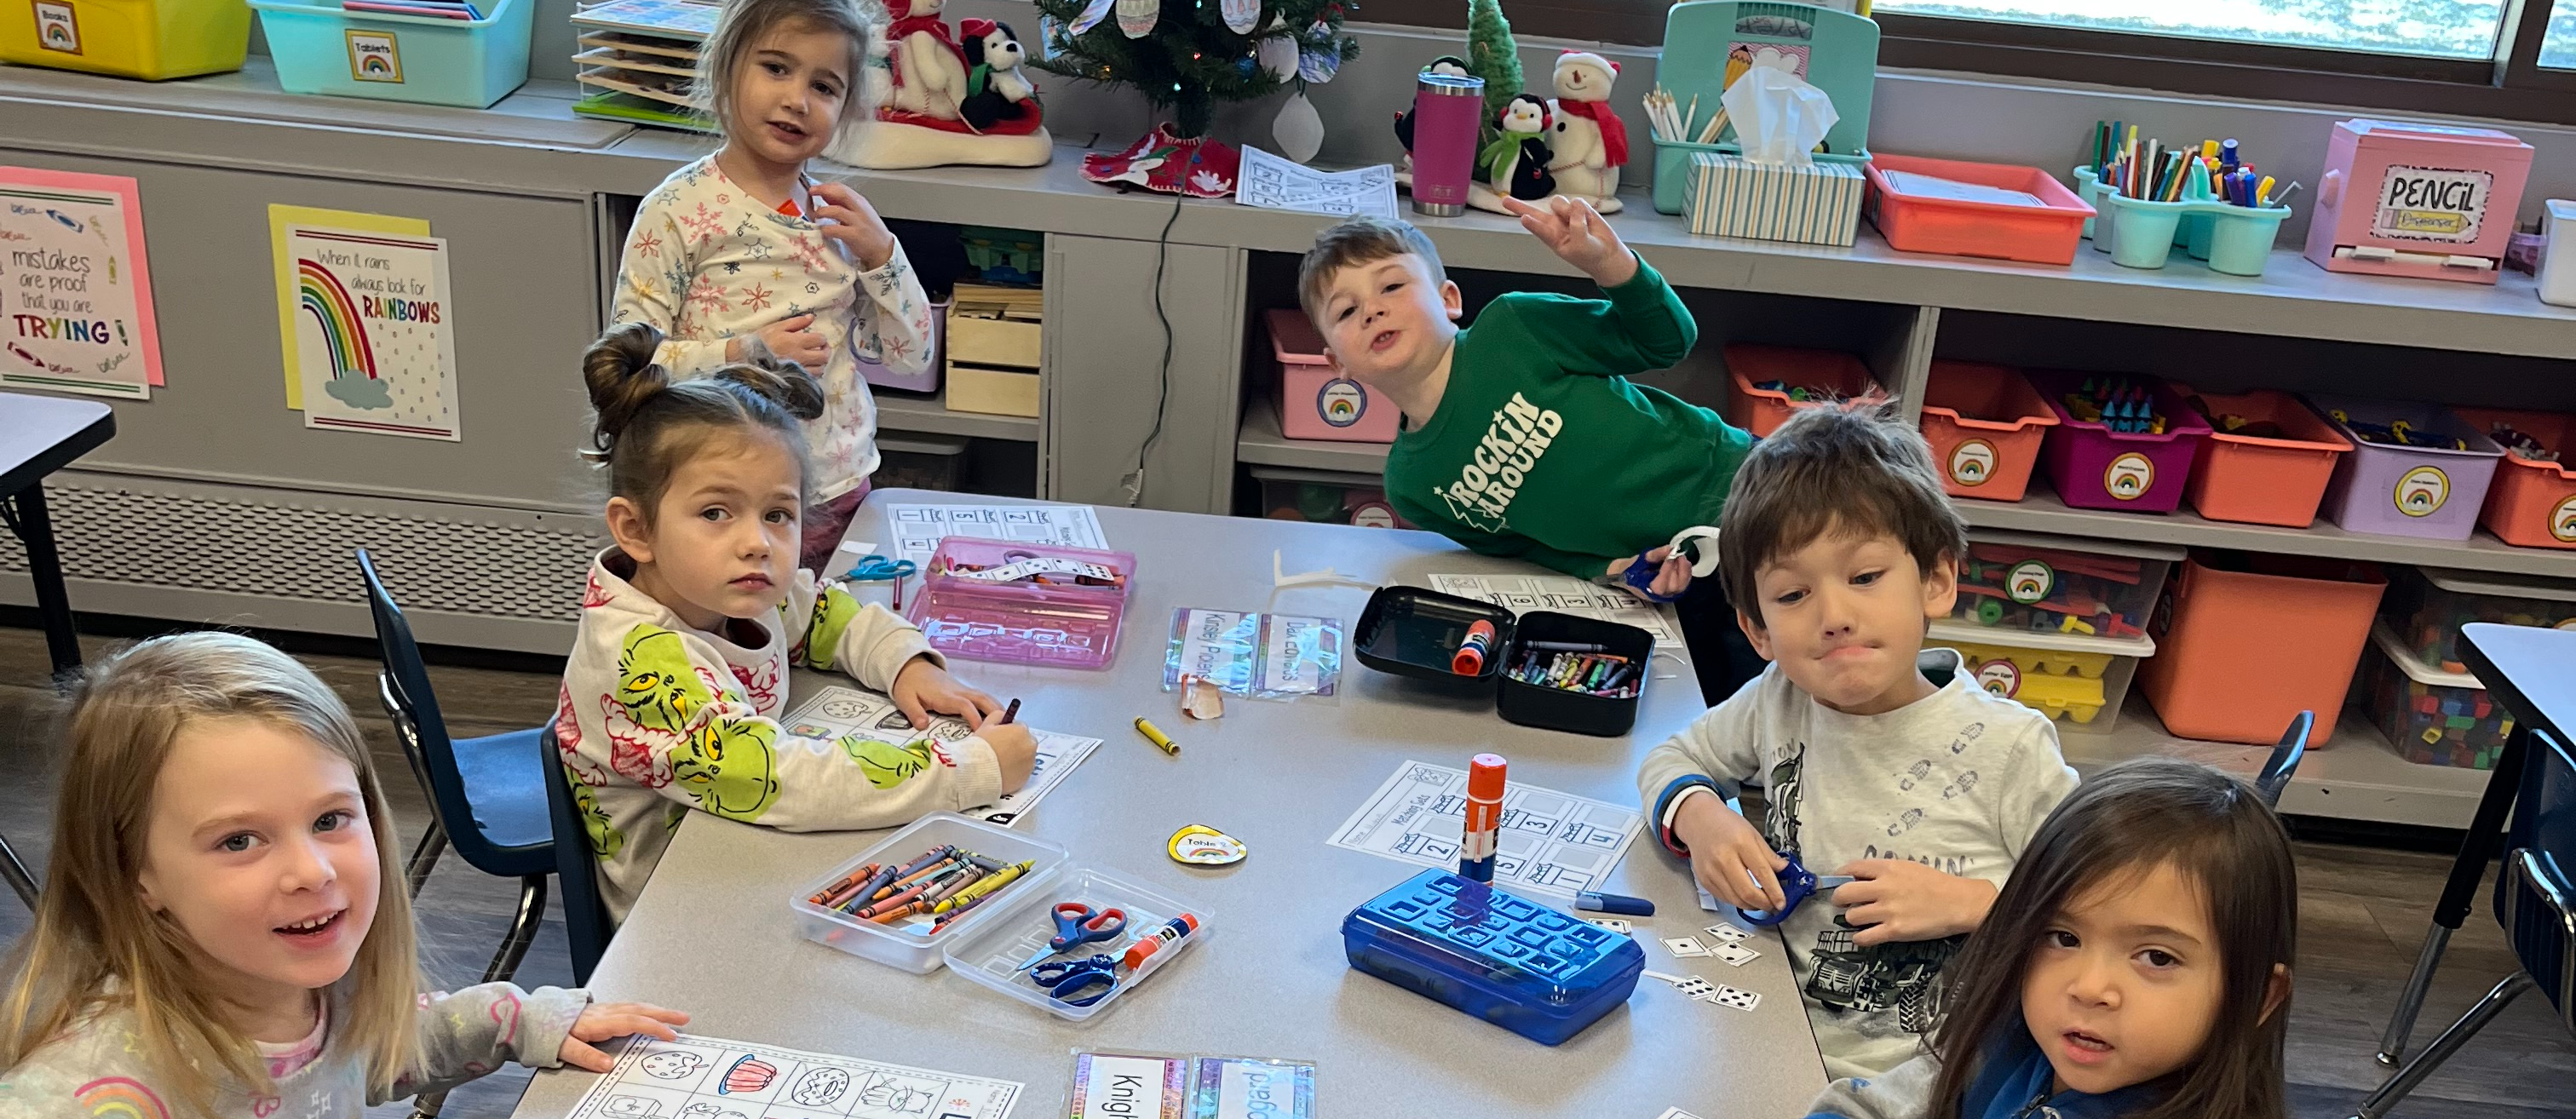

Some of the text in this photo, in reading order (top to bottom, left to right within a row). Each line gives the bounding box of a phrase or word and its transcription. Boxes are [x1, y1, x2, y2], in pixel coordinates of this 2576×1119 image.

[355, 43, 390, 53] Tablets
[13, 248, 90, 273] mistakes
[317, 249, 351, 267] When
[365, 256, 390, 271] rains
[20, 273, 88, 292] are proof
[351, 273, 427, 296] always look for
[22, 292, 93, 315] that you are
[363, 296, 440, 324] RAINBOWS
[13, 314, 109, 344] TRYING
[1449, 392, 1539, 508] ROCKIN
[1477, 410, 1563, 519] AROUND
[1391, 795, 1431, 826] Matching Sets
[1526, 821, 1548, 829] 3
[1427, 845, 1450, 855] 2
[1591, 834, 1614, 843] 4
